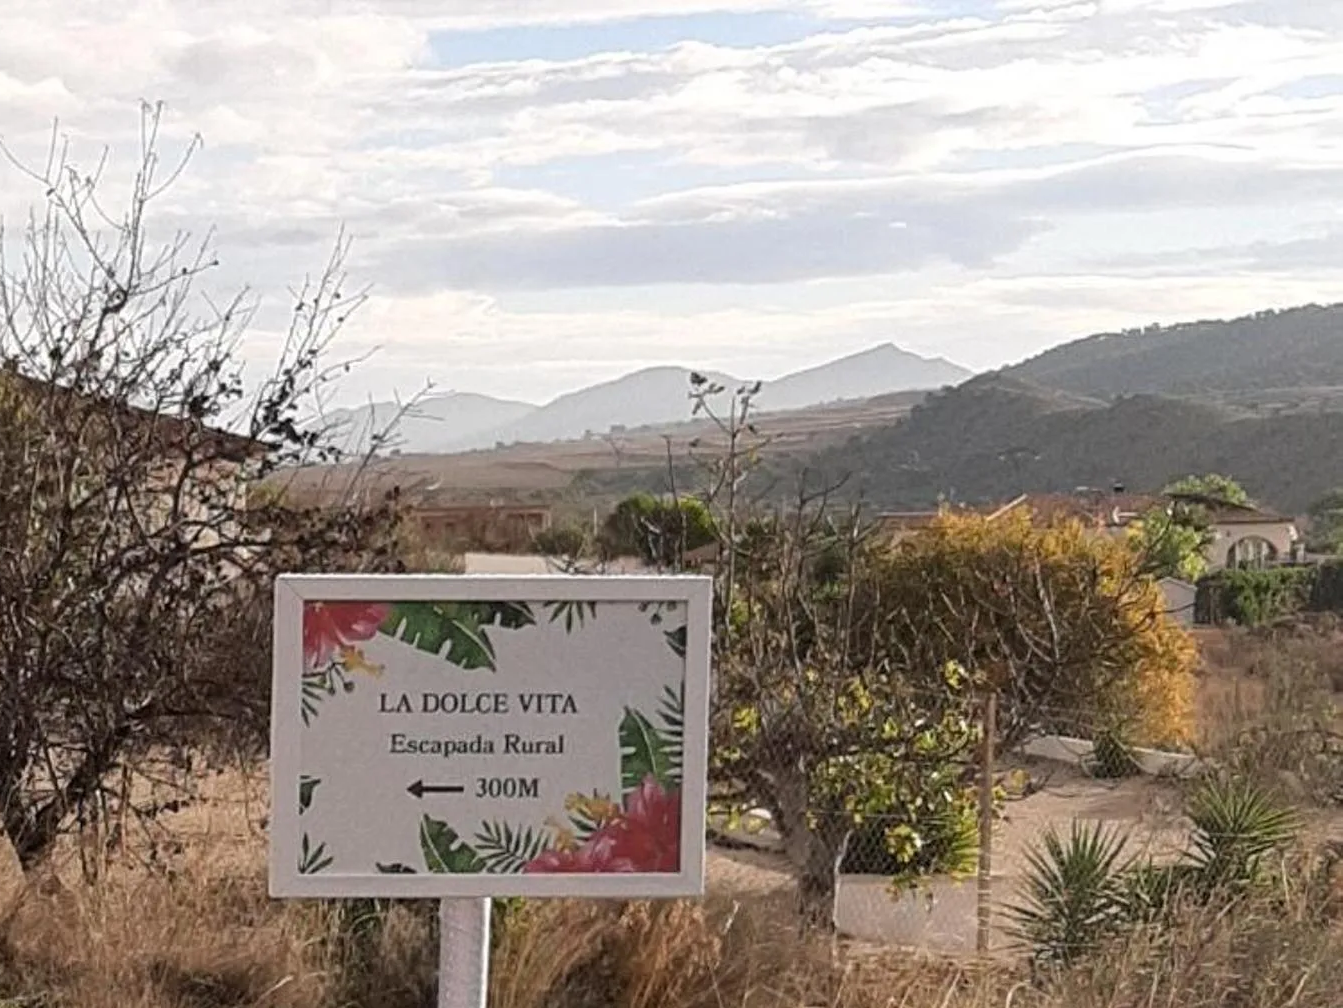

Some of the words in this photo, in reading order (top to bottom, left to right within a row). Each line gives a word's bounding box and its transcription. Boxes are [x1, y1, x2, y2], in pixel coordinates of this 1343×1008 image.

[378, 693, 412, 714] LA
[422, 693, 509, 714] DOLCE
[518, 693, 578, 714] VITA
[389, 734, 495, 758] Escapada
[504, 734, 565, 755] Rural
[475, 778, 539, 799] 300M
